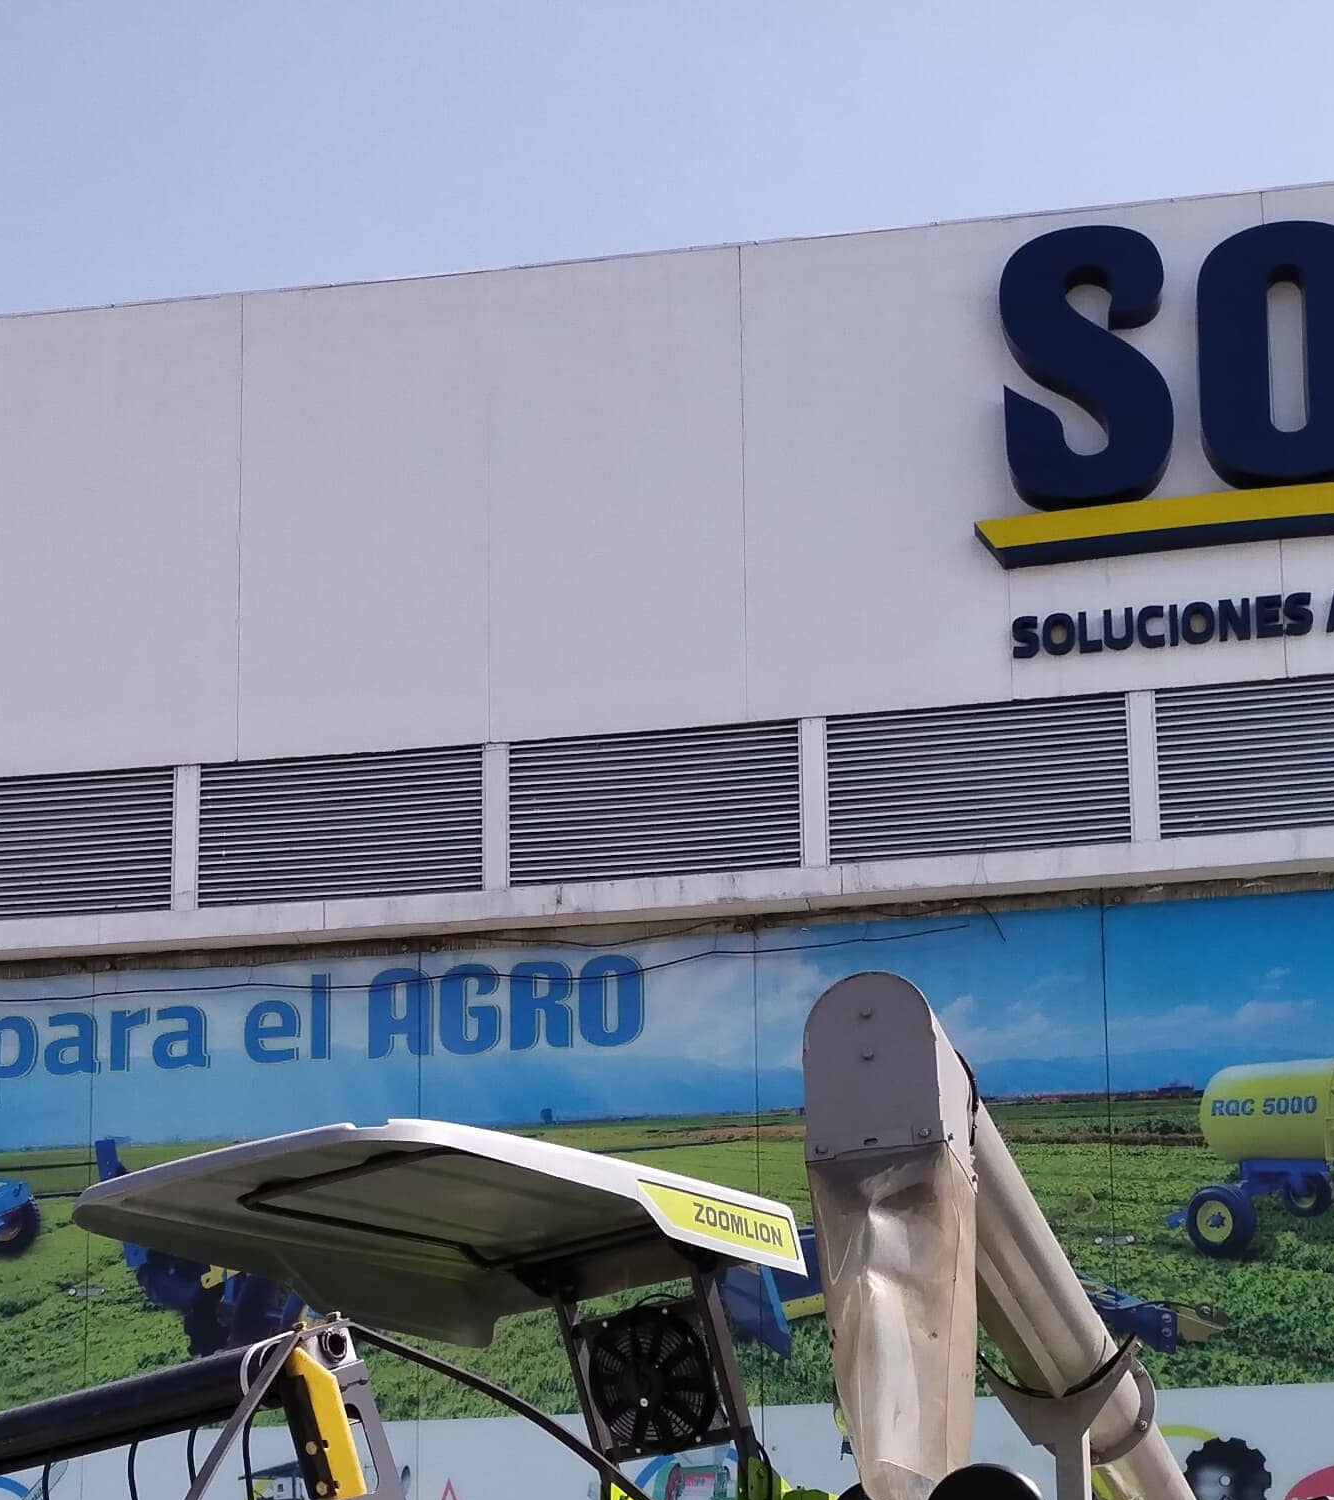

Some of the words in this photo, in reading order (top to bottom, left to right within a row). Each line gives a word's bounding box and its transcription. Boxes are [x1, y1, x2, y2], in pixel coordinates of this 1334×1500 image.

[1011, 591, 1314, 660] SOLUCIONES
[243, 984, 332, 1066] el
[367, 953, 646, 1060] AGRO
[1211, 1098, 1255, 1116] RQC
[1262, 1095, 1317, 1116] 5000
[692, 1201, 784, 1248] ZOOMLION
